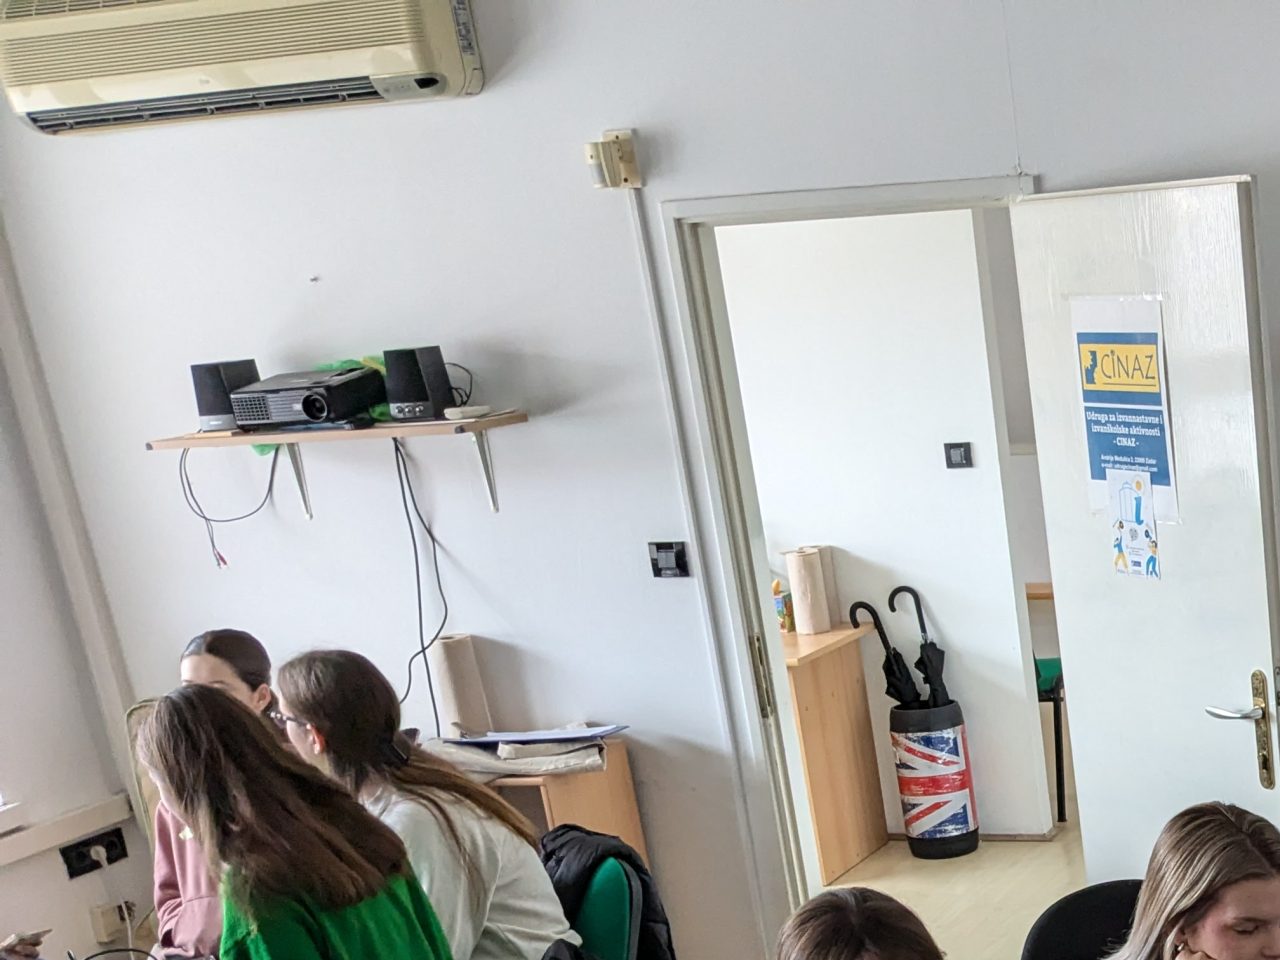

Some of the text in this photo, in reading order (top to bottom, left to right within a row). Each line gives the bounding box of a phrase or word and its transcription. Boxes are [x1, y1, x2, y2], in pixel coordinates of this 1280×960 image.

[1086, 411, 1109, 424] Udruga
[1109, 414, 1116, 422] za
[1116, 412, 1159, 425] izvannastavne
[1130, 425, 1161, 437] aktivnosti
